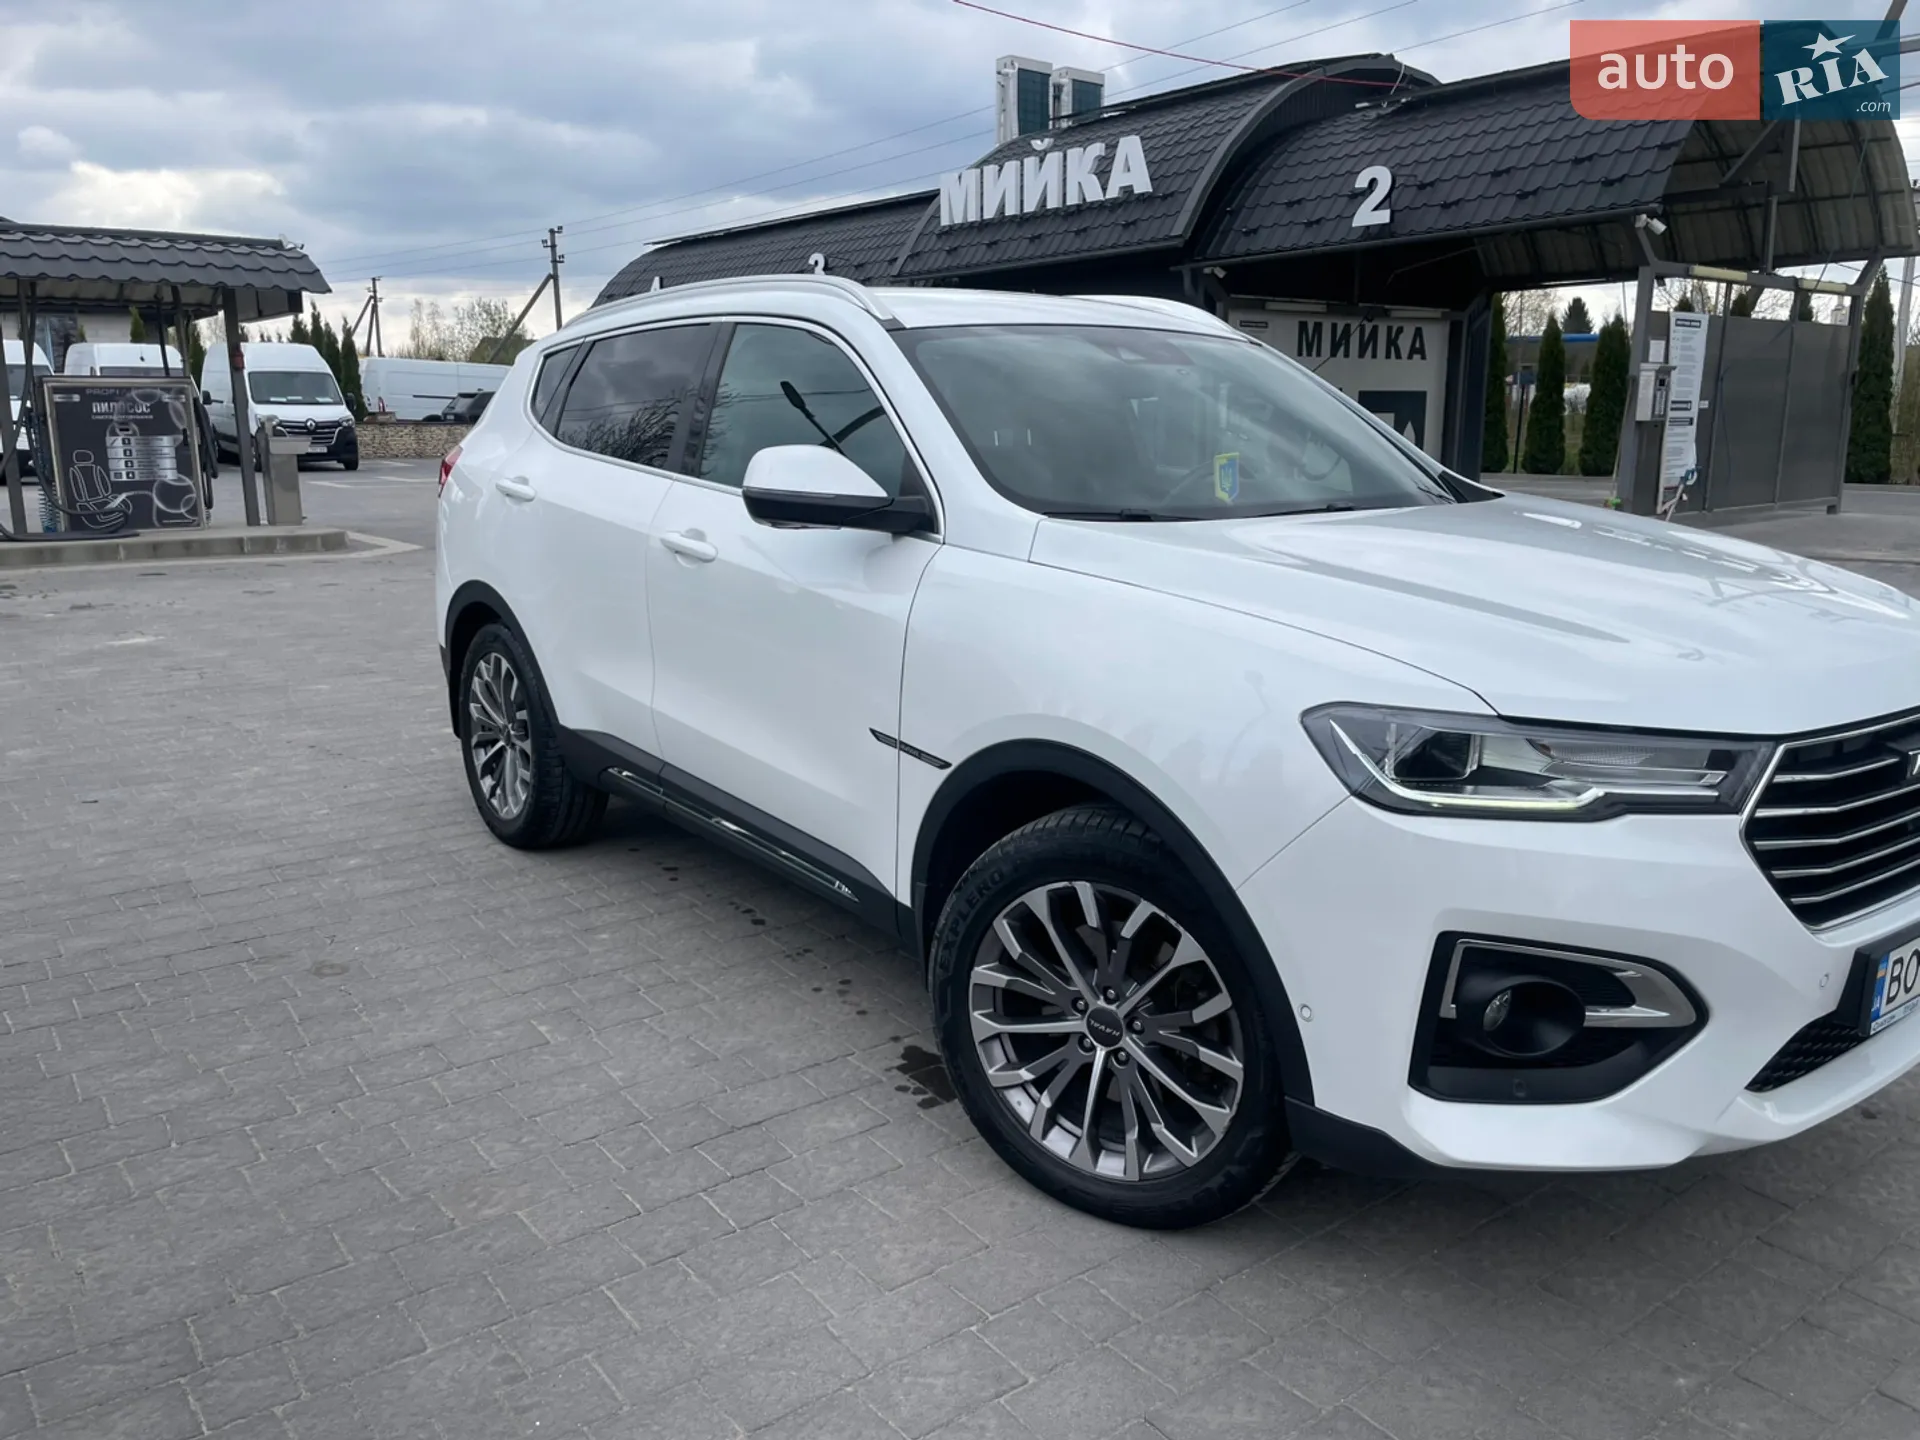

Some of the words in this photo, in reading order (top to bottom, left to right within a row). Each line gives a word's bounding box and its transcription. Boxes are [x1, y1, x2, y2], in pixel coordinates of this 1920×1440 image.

[939, 134, 1153, 227] МИЙКА
[1352, 165, 1394, 228] 2
[1296, 318, 1427, 361] МИЙКА
[938, 868, 1005, 974] EXPLERO
